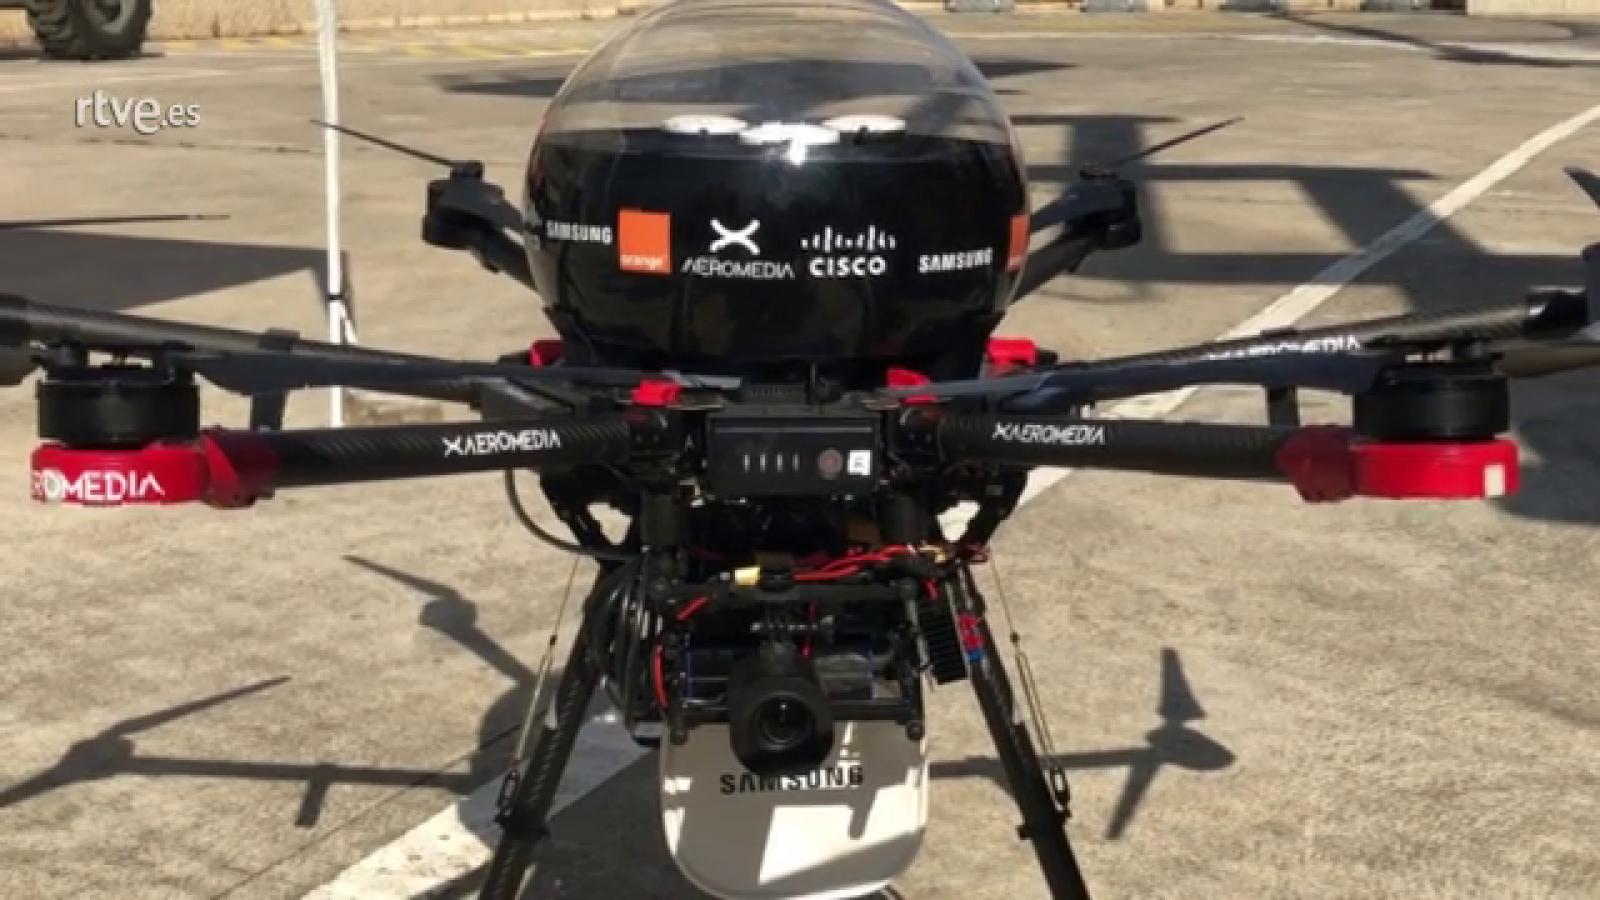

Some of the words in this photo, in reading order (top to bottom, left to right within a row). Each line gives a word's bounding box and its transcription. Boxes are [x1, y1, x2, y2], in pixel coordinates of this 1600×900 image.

[546, 220, 613, 245] SAMSUNG
[682, 256, 796, 280] AEROMEDIA
[808, 254, 888, 278] CISCO
[917, 247, 994, 274] SAMSUNG
